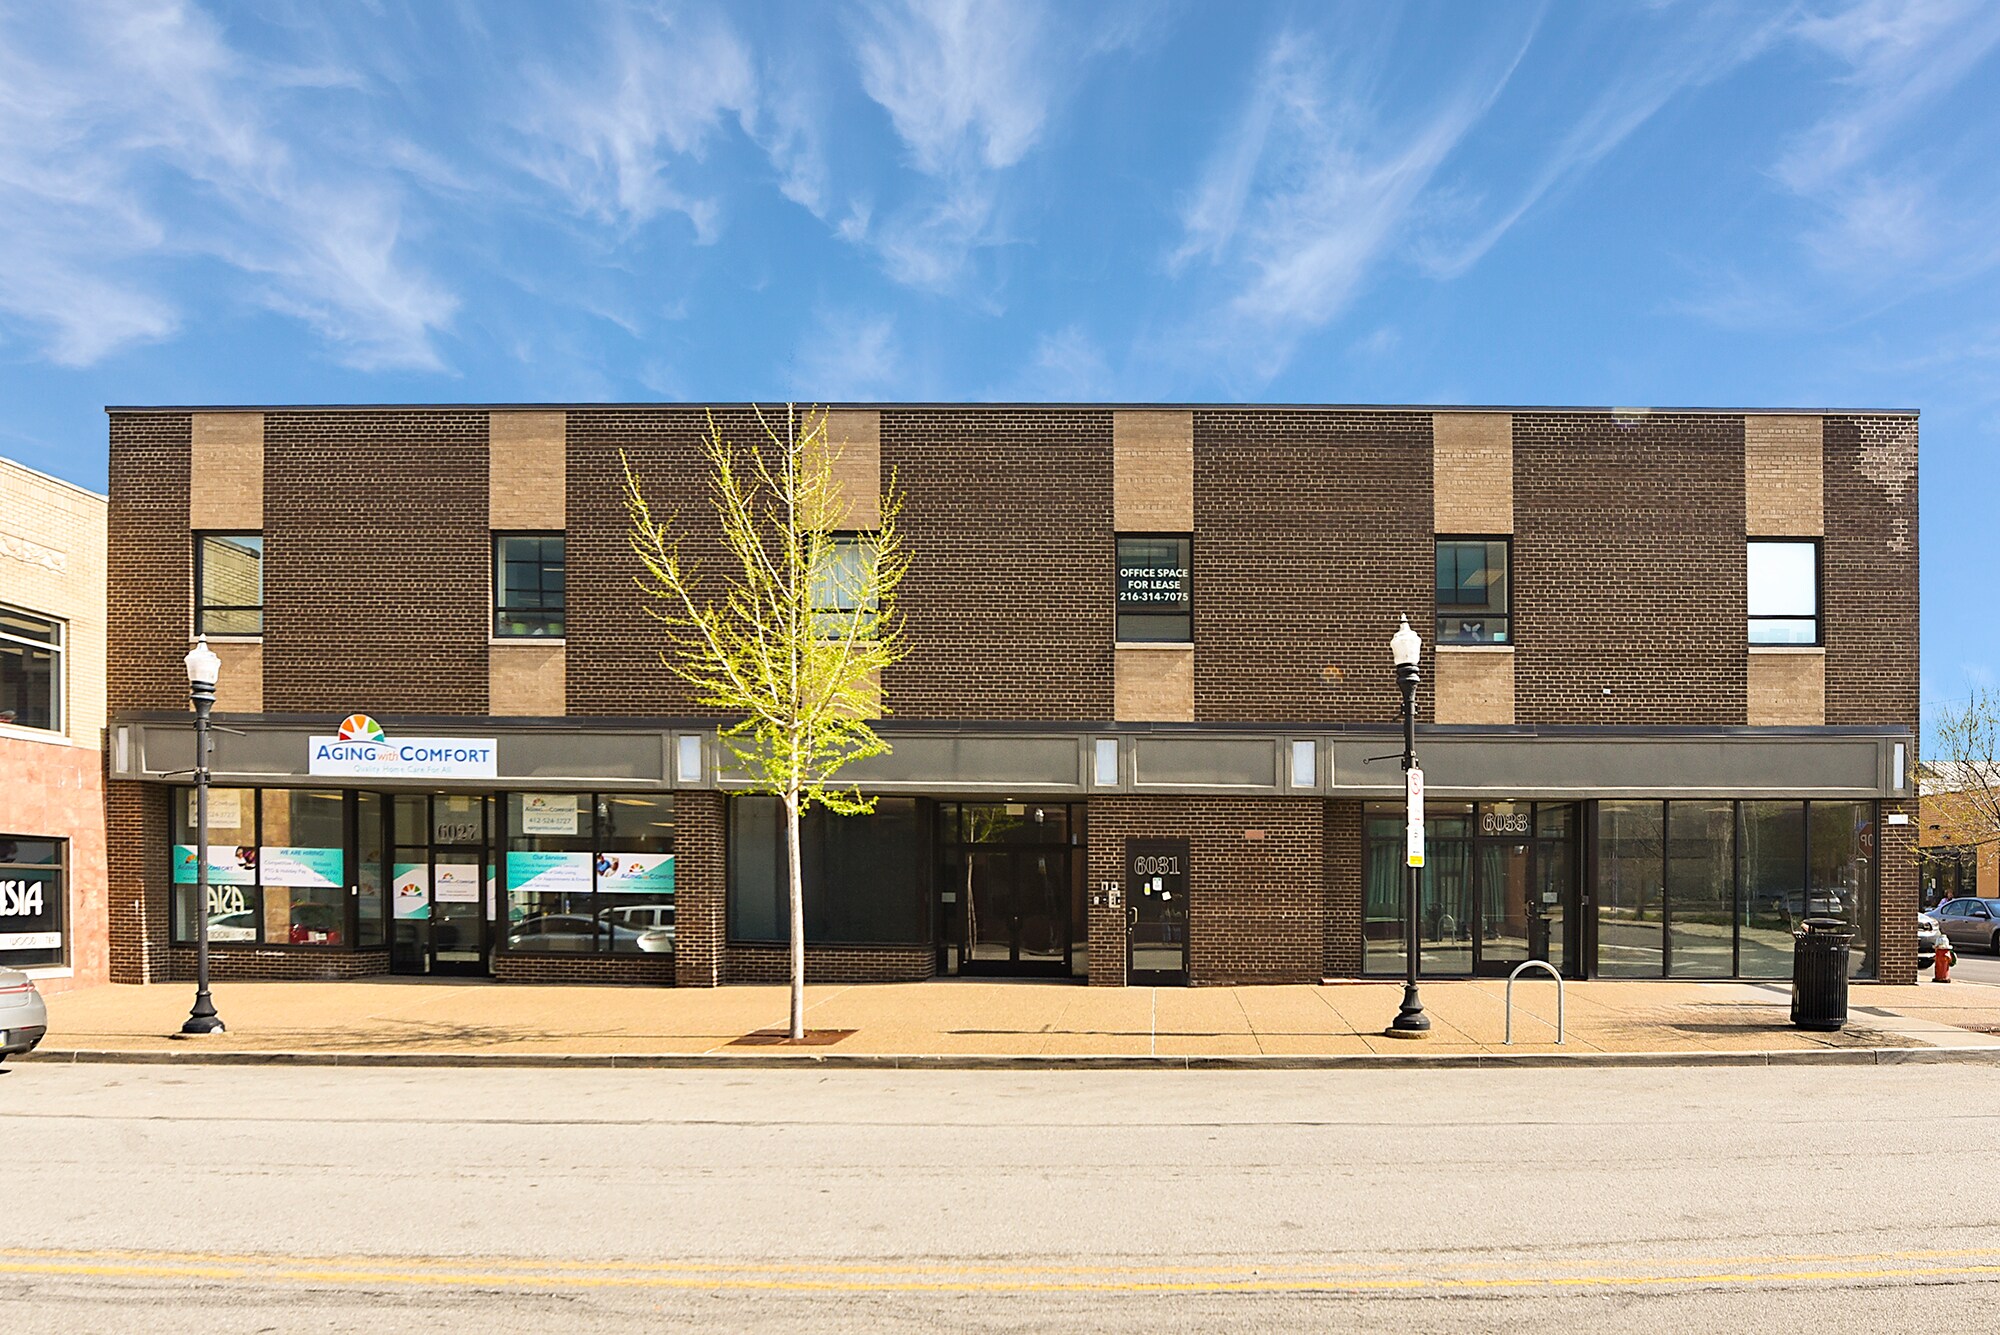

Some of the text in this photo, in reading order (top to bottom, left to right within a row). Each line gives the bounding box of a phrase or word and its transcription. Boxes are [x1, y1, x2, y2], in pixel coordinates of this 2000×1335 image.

[1120, 568, 1188, 577] OFFICE SPACE
[1128, 581, 1180, 589] FOR LEASE
[1120, 592, 1189, 601] 216-314-7075
[317, 745, 490, 763] AGING with COMFORT
[382, 765, 404, 773] Home
[408, 765, 424, 773] Care
[427, 765, 440, 773] For
[442, 765, 452, 773] All
[1483, 813, 1528, 832] 6033
[438, 824, 478, 841] 6027
[1134, 856, 1181, 875] 6031
